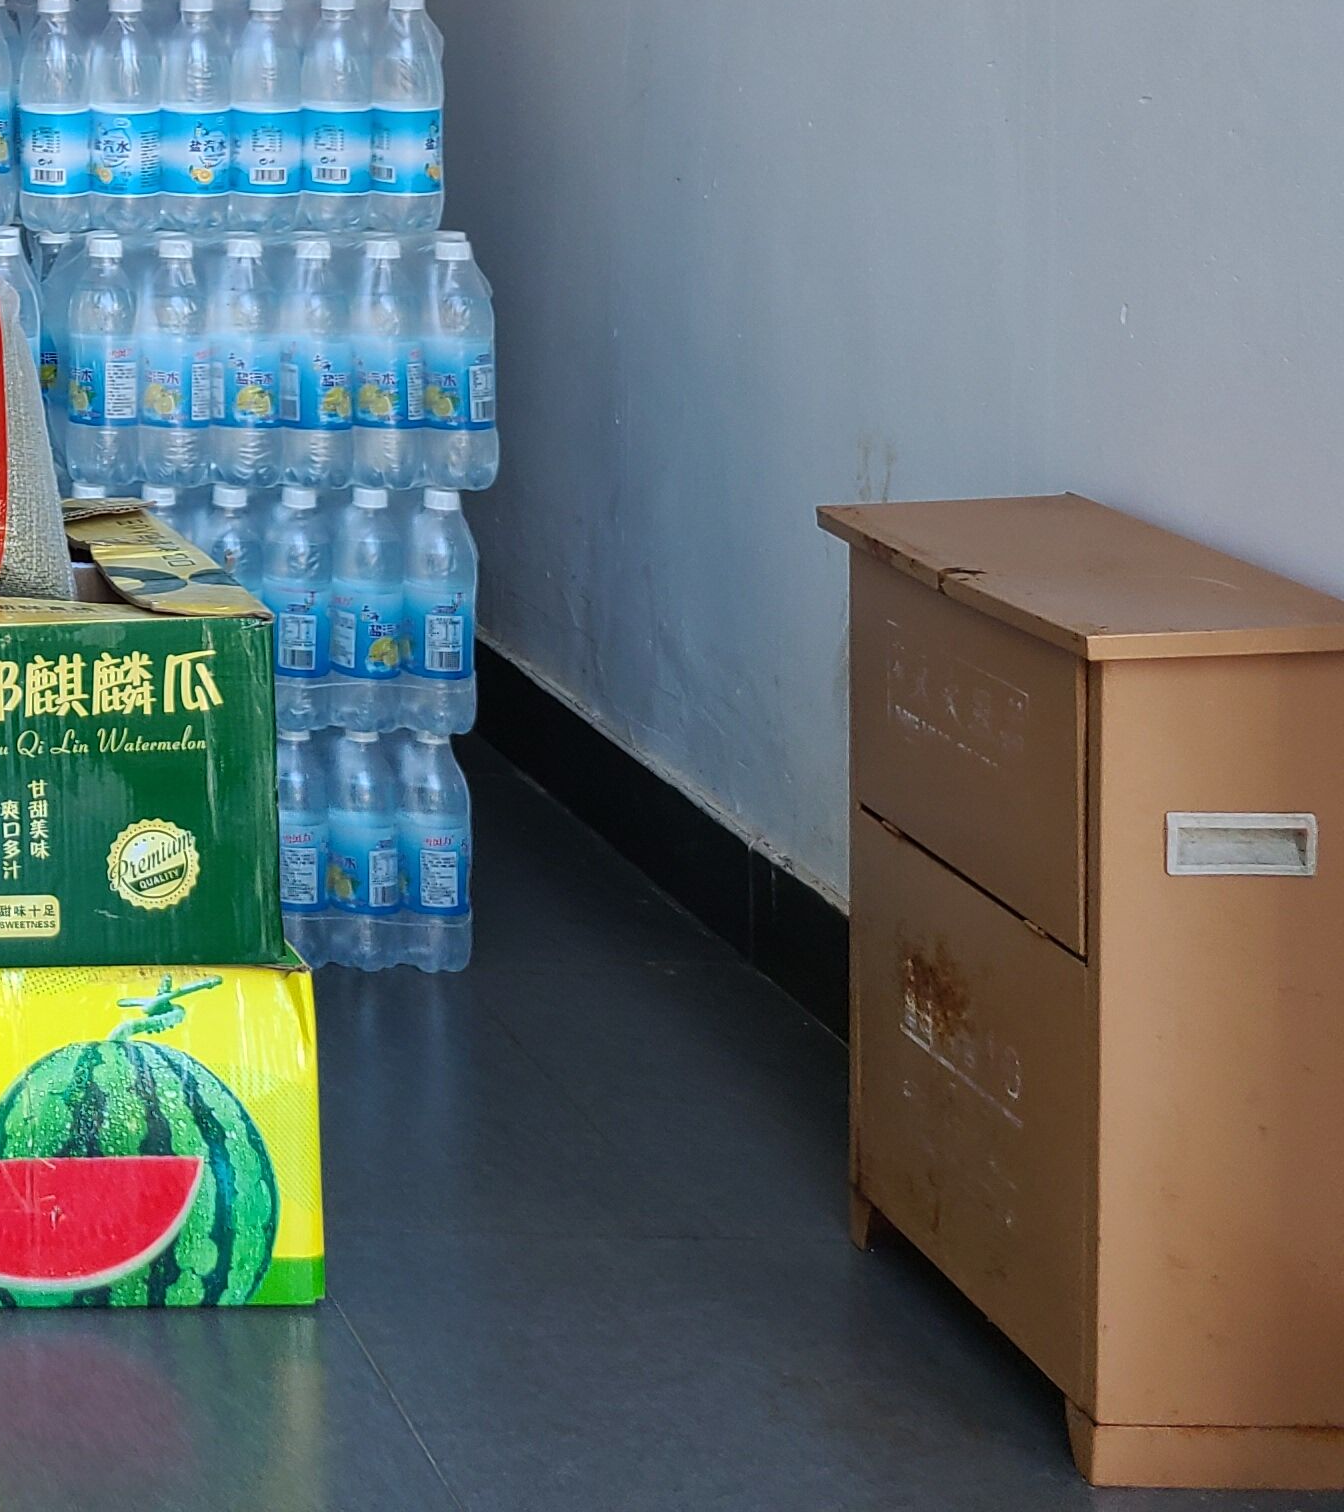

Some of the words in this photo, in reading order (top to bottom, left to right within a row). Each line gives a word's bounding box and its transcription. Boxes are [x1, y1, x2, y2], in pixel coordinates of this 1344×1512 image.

[18, 730, 45, 758] Qi
[50, 727, 90, 755] Lin
[97, 725, 208, 753] Watermelon
[27, 779, 50, 860] 甘甜美味
[1, 800, 23, 880] 爽口多汁
[109, 830, 192, 888] Premium
[139, 869, 179, 889] QUALITY
[0, 904, 56, 918] 甜味十足
[0, 920, 56, 929] SWEETNESS
